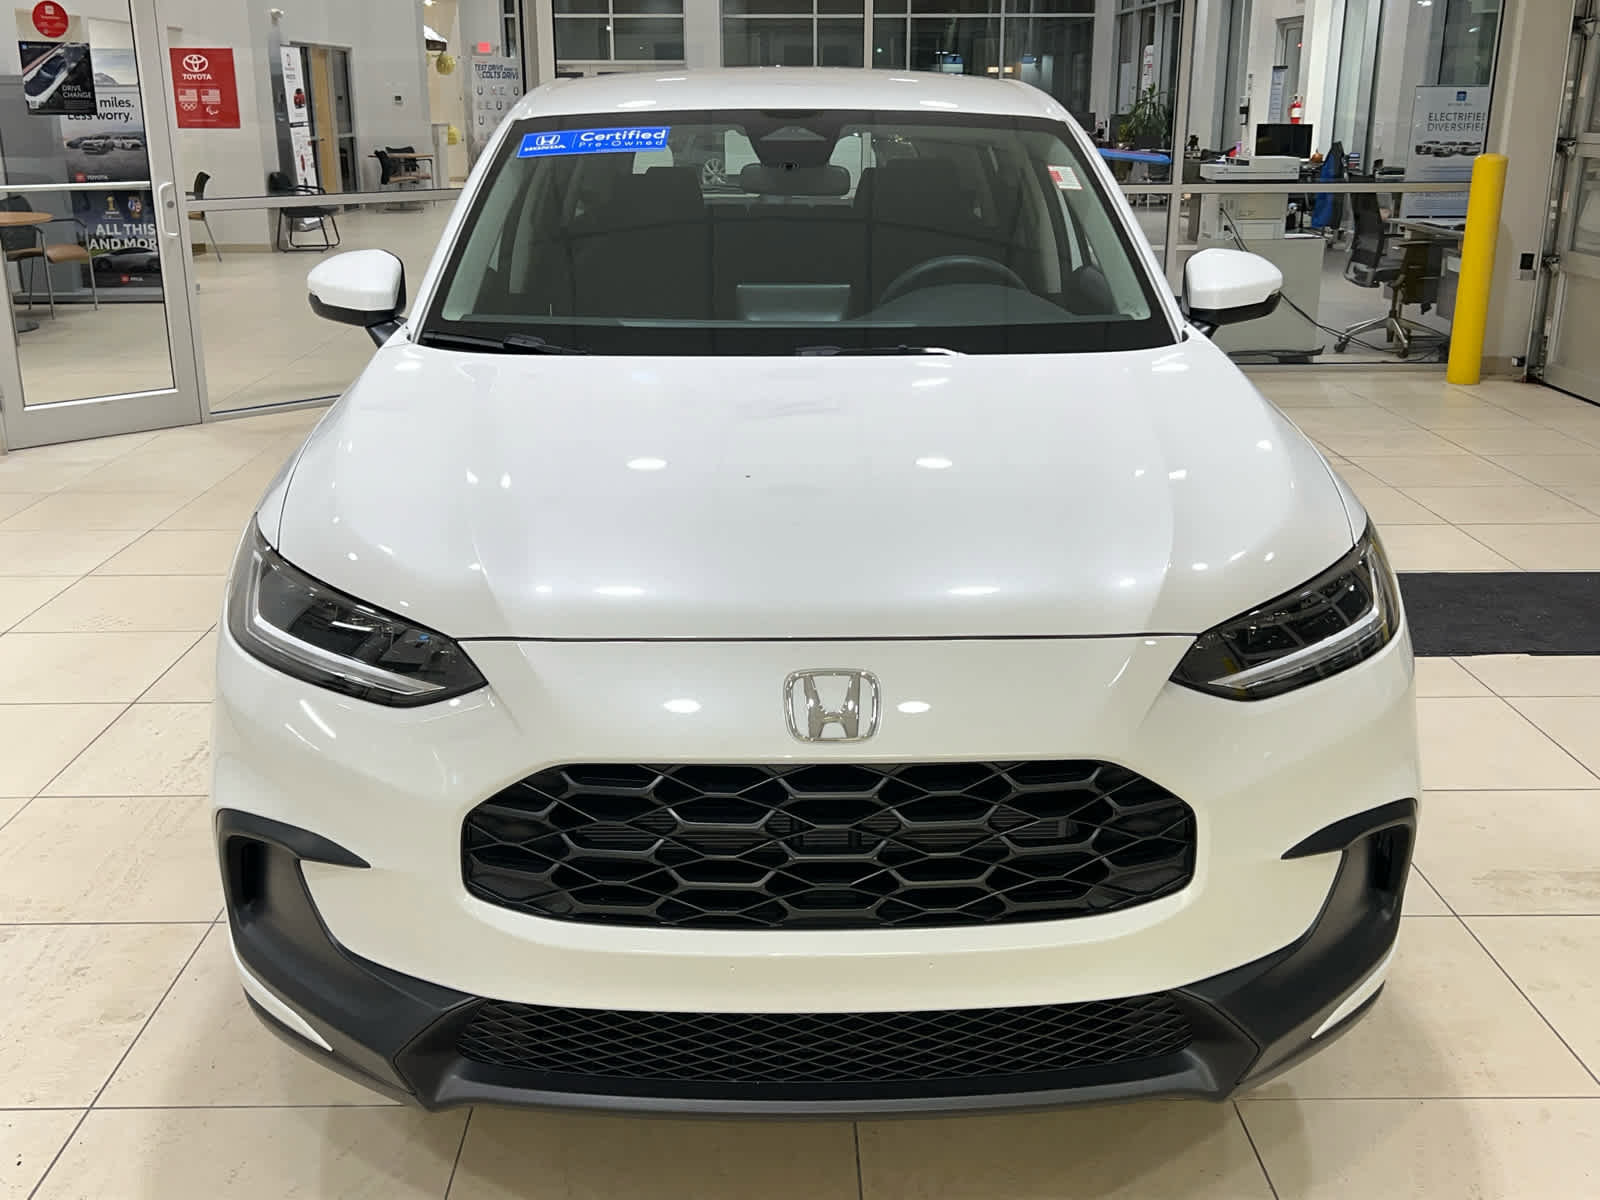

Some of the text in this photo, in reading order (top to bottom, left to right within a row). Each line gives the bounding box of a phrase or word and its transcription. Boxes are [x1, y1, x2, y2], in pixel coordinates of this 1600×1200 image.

[100, 96, 135, 108] miles.
[96, 111, 133, 123] worry.
[580, 129, 667, 142] Certified
[578, 138, 664, 149] Pre-Owned
[96, 223, 156, 235] ALL THIS
[89, 238, 121, 250] AND
